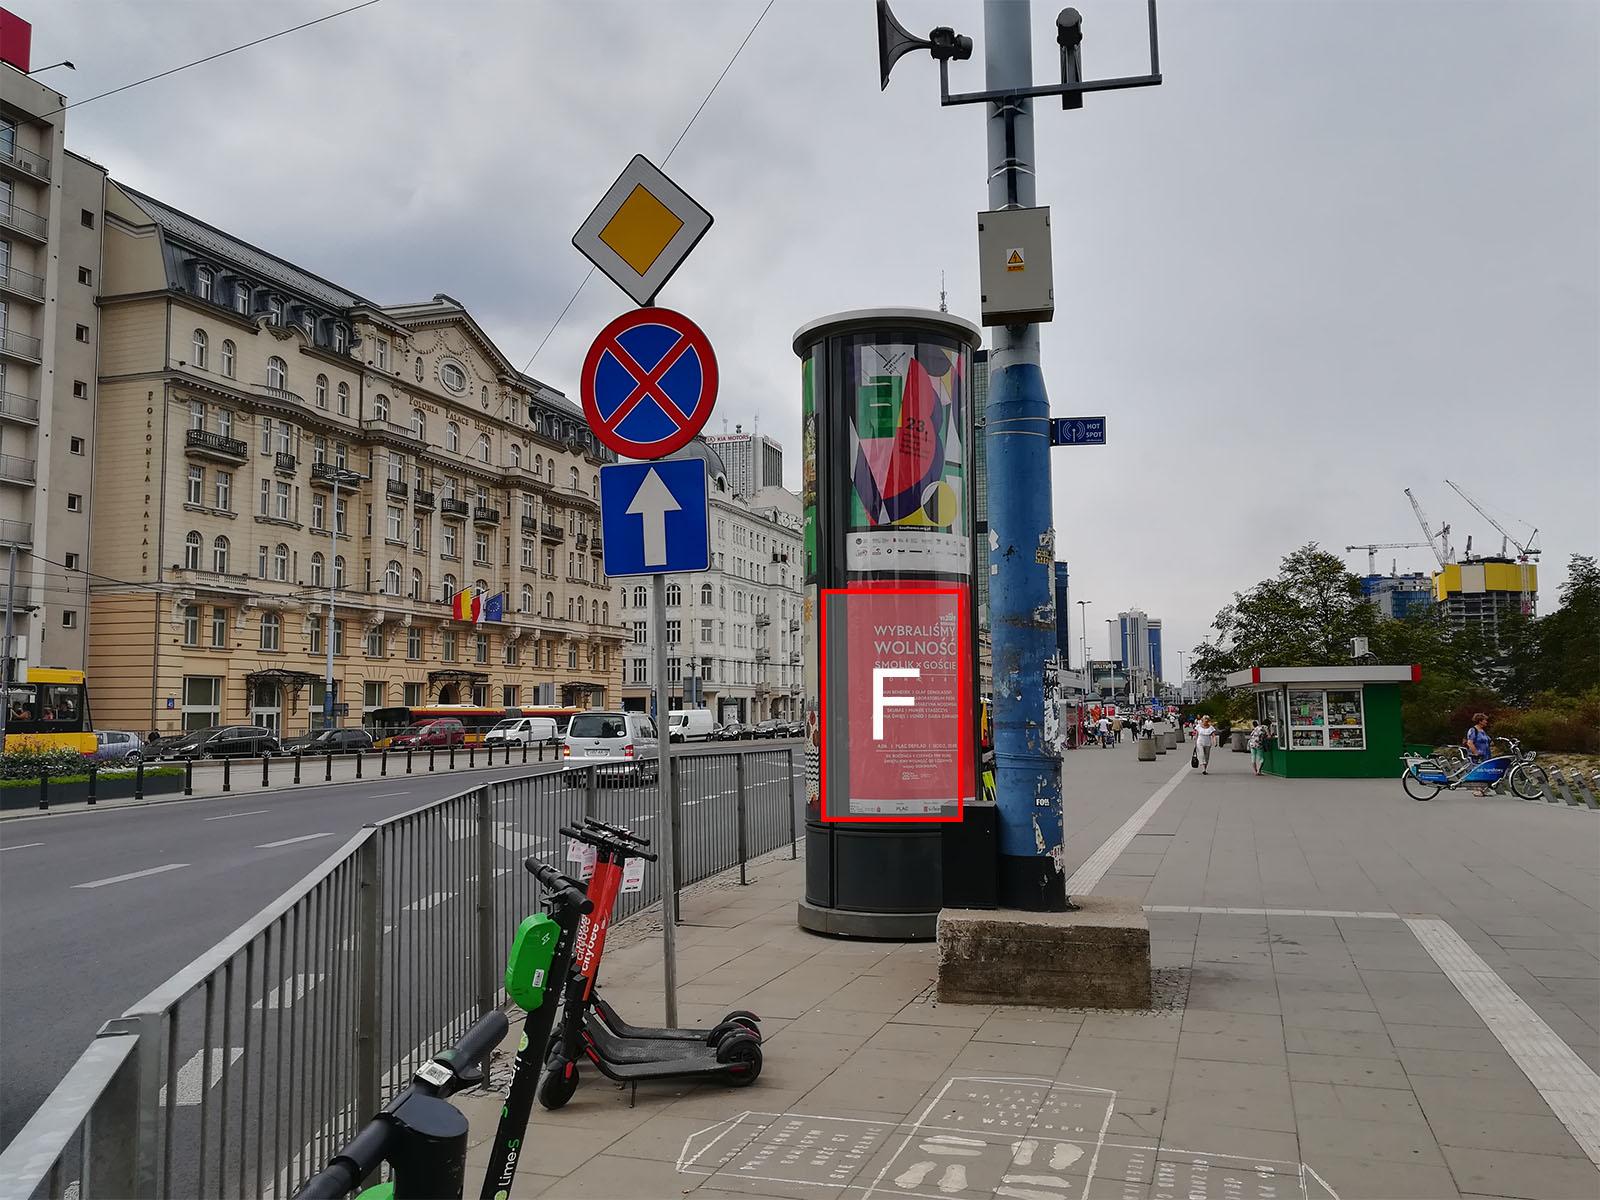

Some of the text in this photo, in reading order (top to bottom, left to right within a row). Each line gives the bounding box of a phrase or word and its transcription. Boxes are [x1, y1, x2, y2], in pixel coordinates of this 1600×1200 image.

[408, 394, 496, 436] POLONIA PALACE HOTEL
[142, 391, 153, 575] POLONIA PALACE
[873, 622, 956, 637] WYBRALIŚMY
[873, 638, 957, 655] WOLNOŚĆ
[874, 660, 914, 669] SMOLIK
[923, 658, 957, 670] GOŚCIE
